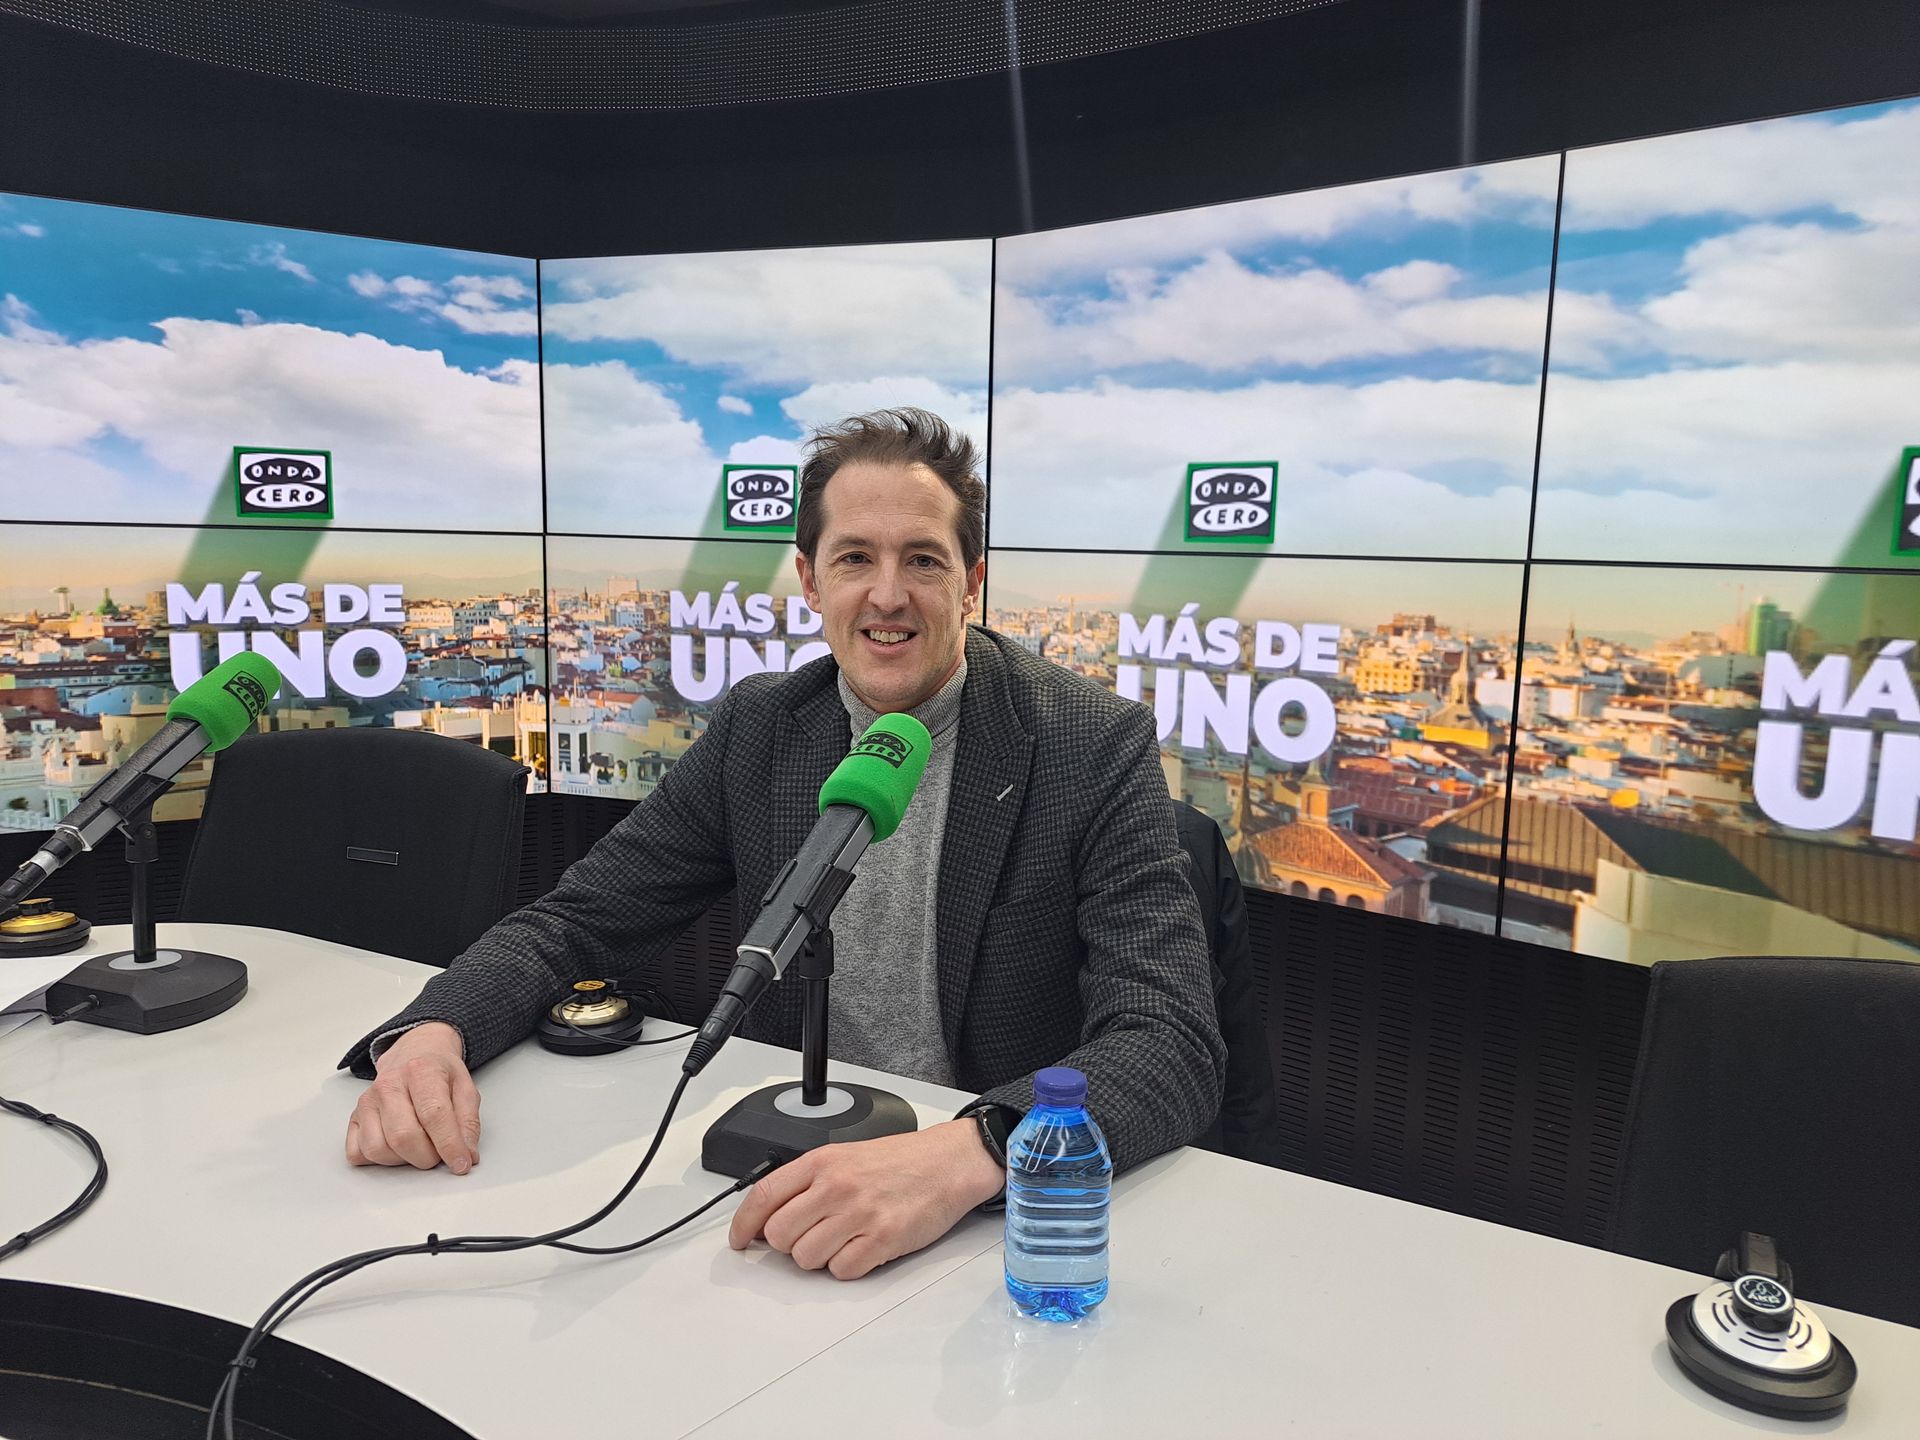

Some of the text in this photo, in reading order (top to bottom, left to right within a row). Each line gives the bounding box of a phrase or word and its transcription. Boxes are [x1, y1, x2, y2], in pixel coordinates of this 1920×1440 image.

[250, 464, 316, 479] ONDA
[735, 480, 786, 493] ONDA
[256, 488, 316, 503] CERO
[1200, 481, 1261, 498] ONDA
[739, 503, 784, 517] CERO
[1203, 509, 1259, 525] CERO
[165, 571, 406, 626] MÁS DE
[669, 581, 824, 635] MÁS D
[1117, 602, 1341, 675] MÁS DE
[169, 628, 408, 700] UNO
[670, 634, 834, 702] UN
[1116, 664, 1337, 764] UNO
